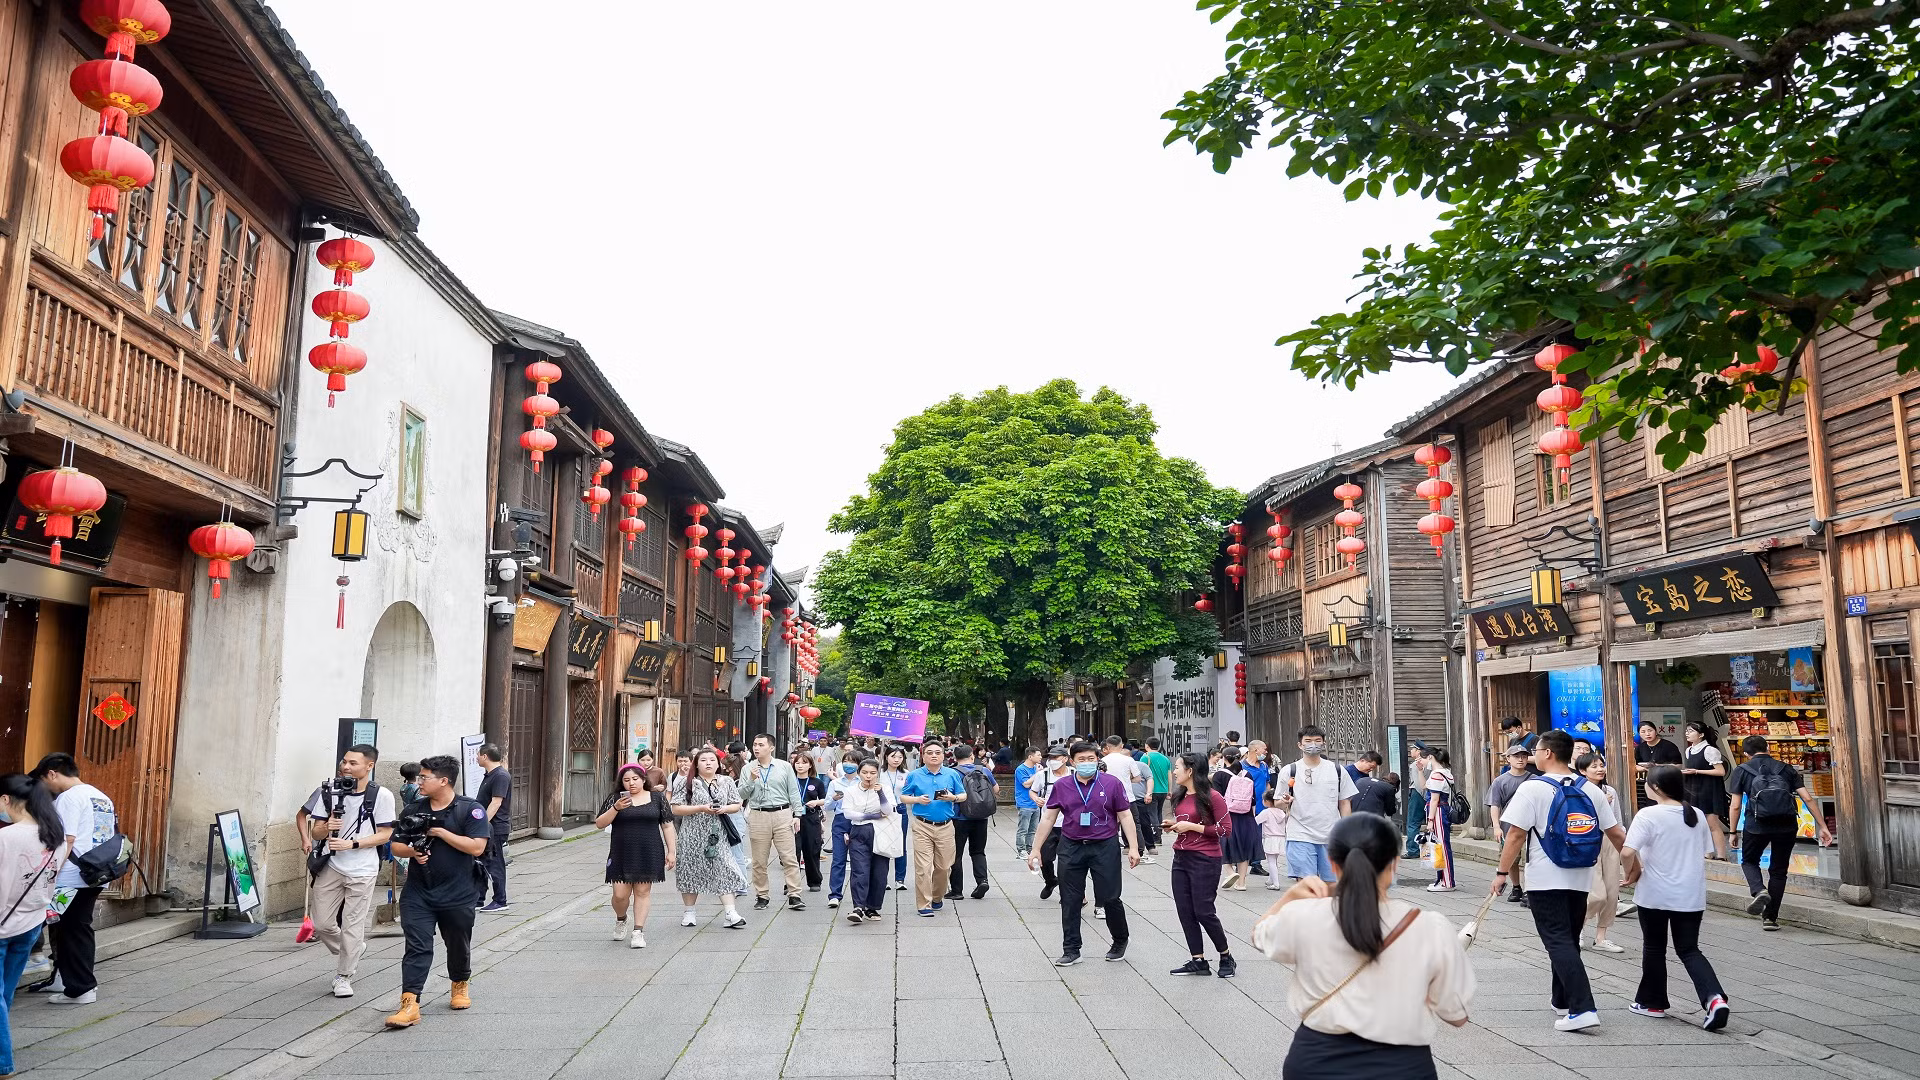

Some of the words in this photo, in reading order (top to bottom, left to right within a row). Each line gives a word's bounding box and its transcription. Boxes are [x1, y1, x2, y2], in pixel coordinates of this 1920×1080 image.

[1637, 567, 1753, 615] 宝岛之恋
[1486, 608, 1559, 639] 遇见台湾
[1157, 686, 1215, 720] 一家有福州味道的
[883, 720, 892, 733] 1
[1158, 722, 1192, 757] 文创商店
